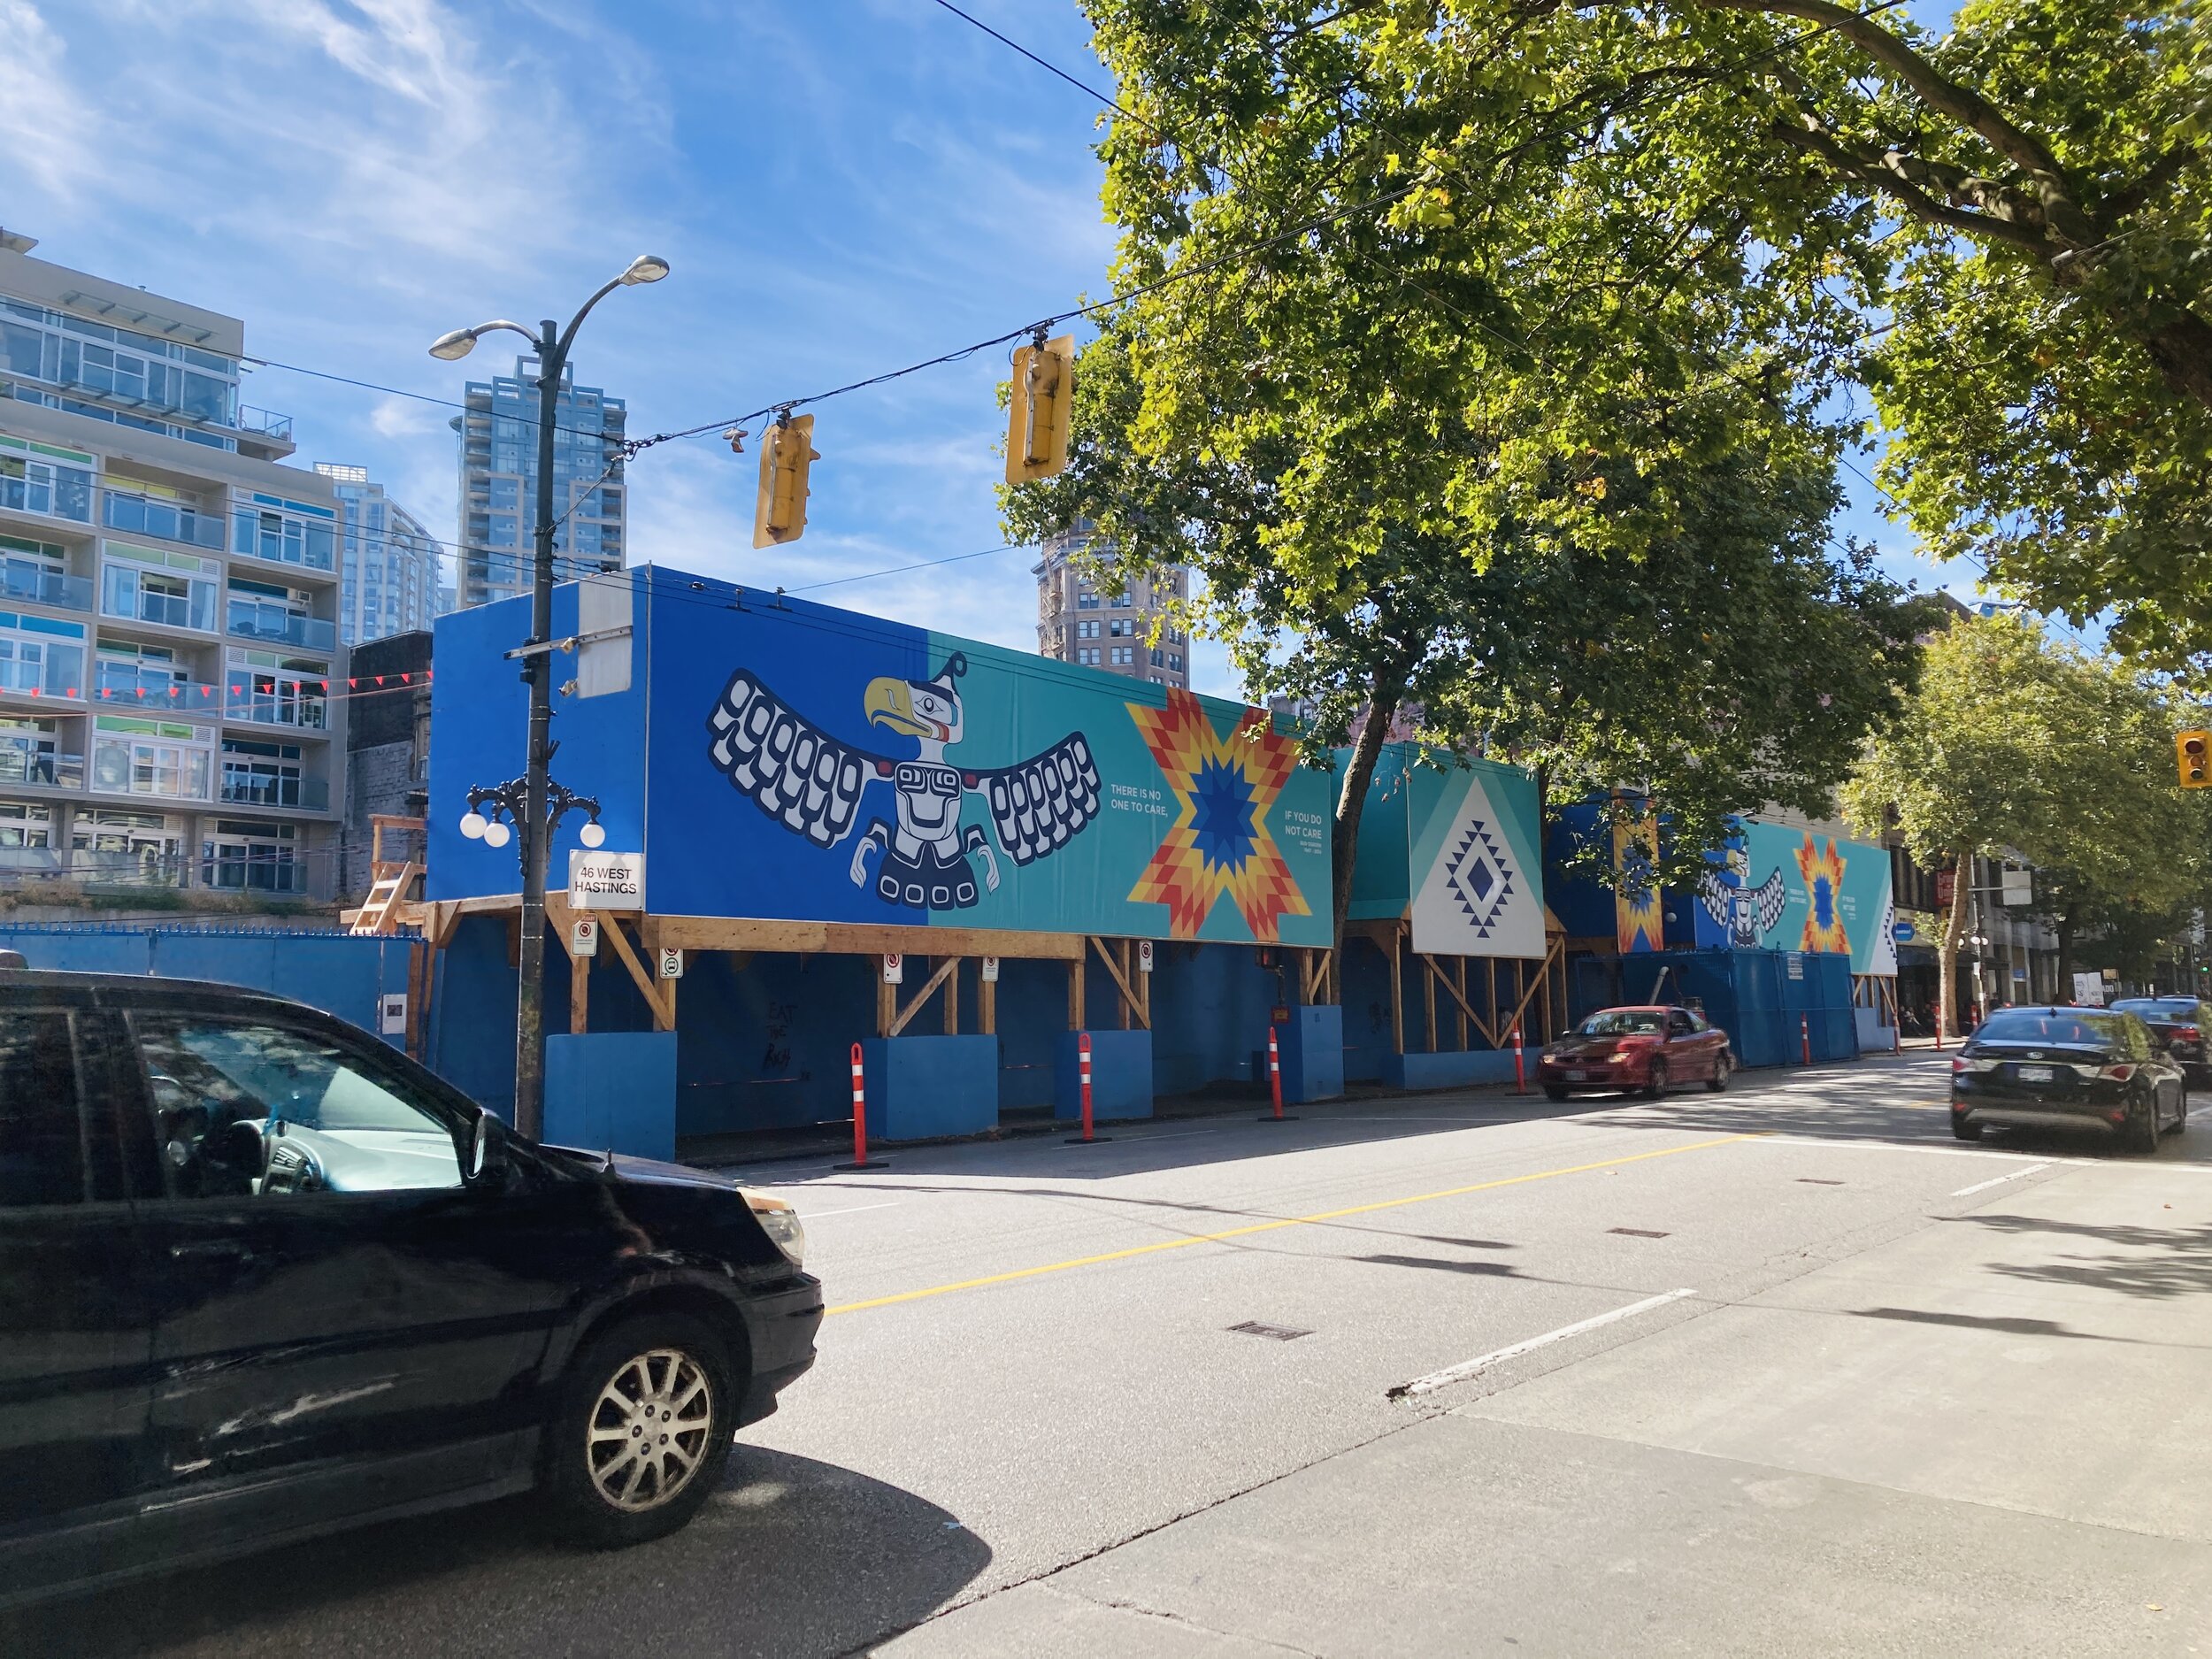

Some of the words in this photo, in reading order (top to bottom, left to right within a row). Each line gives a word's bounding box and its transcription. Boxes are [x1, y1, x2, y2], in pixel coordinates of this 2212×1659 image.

[1110, 783, 1138, 797] THERE
[1140, 788, 1148, 799] IS
[1148, 789, 1161, 801] NO
[1110, 798, 1129, 810] ONE
[1131, 801, 1143, 812] TO
[1144, 803, 1168, 818] CARE,
[1285, 810, 1292, 820] IF
[1293, 811, 1310, 823] YOU
[1310, 814, 1322, 825] DO
[1285, 825, 1301, 835] NOT
[1302, 827, 1322, 839] CARE
[580, 867, 594, 879] 46
[596, 867, 632, 879] WEST
[574, 881, 637, 895] HASTINGS
[768, 1002, 798, 1024] EAT
